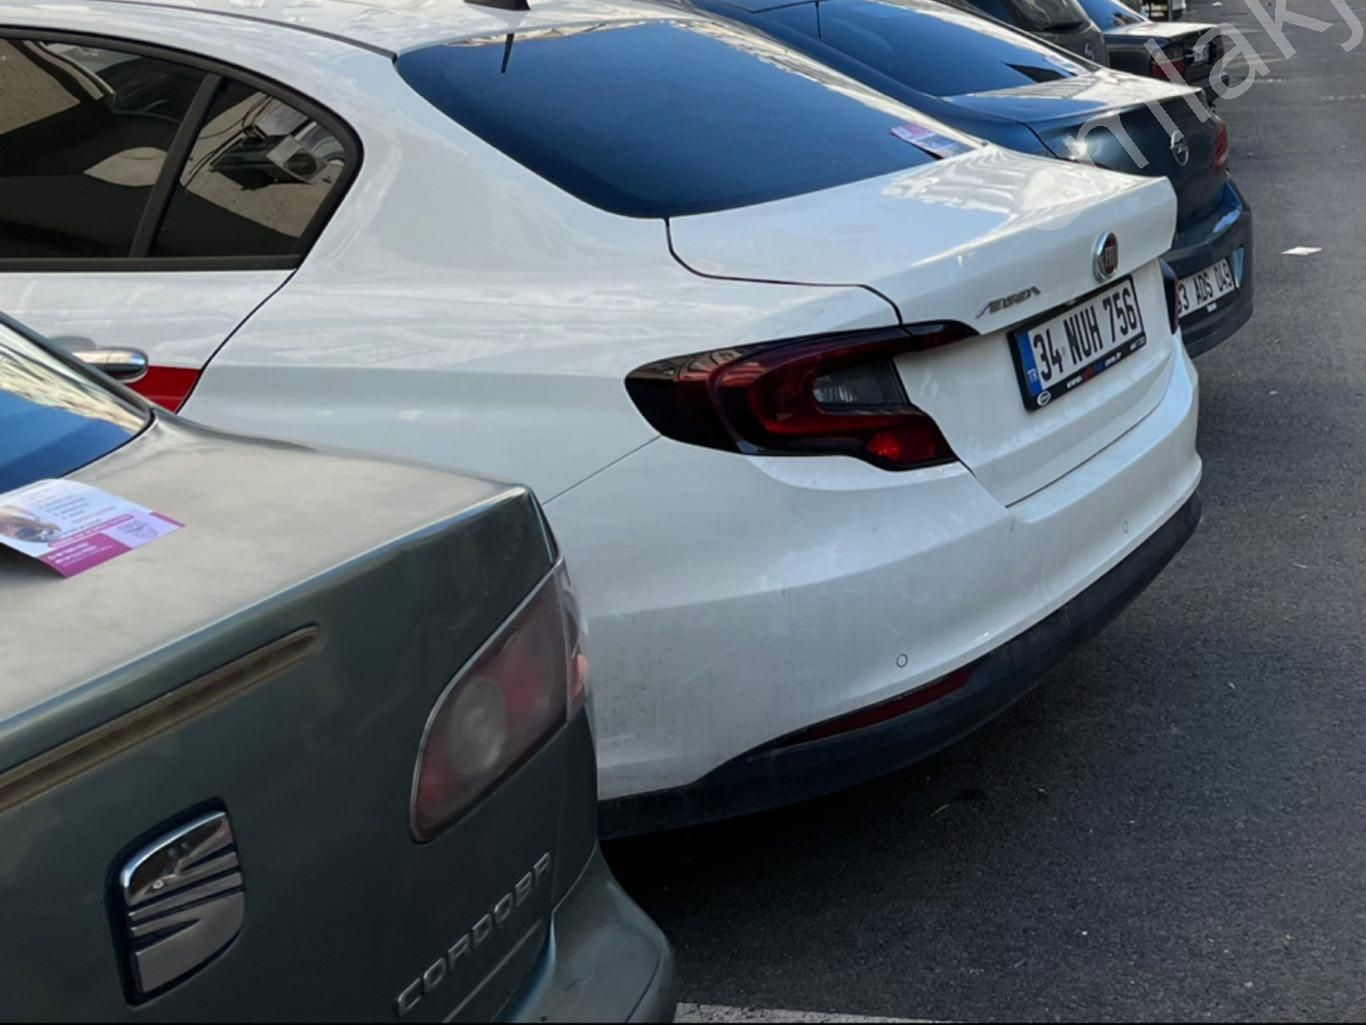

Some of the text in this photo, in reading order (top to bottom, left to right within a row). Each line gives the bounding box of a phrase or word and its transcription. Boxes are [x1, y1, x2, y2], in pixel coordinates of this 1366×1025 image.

[1032, 329, 1066, 382] 34
[1064, 305, 1104, 365] NUH
[1103, 287, 1138, 343] 756
